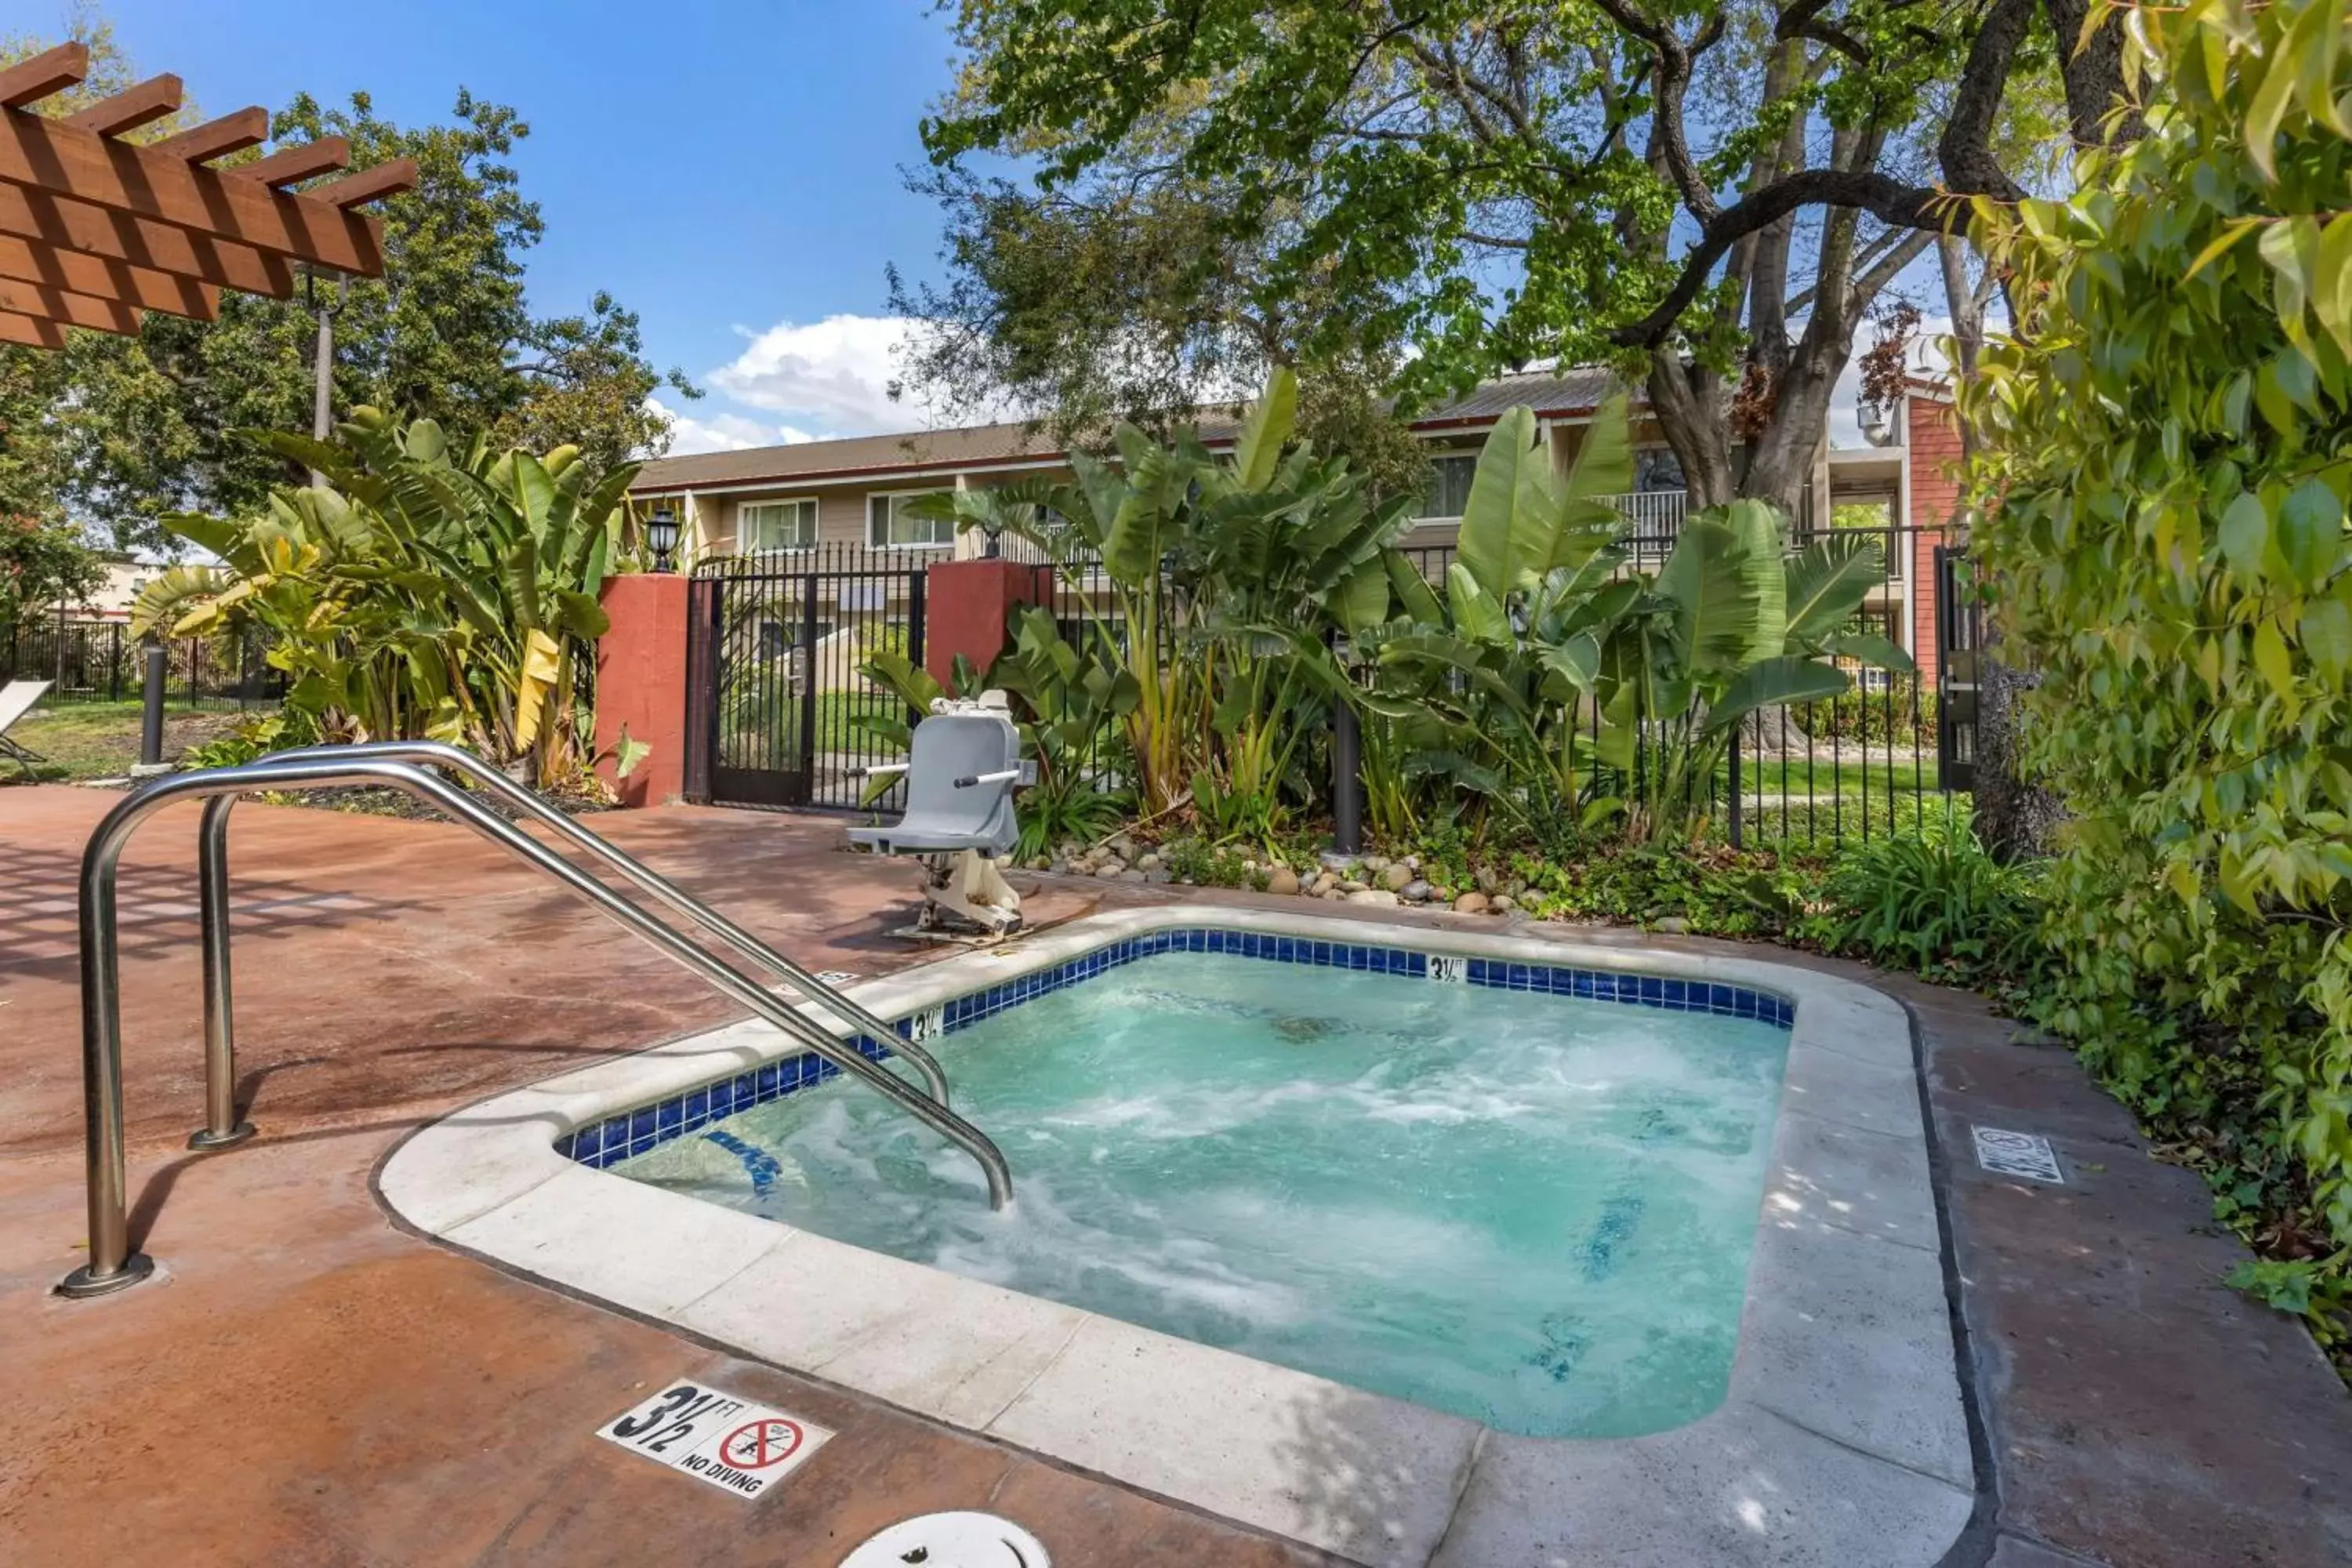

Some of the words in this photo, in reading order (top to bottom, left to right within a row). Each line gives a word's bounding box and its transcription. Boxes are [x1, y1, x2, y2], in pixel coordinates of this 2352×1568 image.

[715, 1399, 744, 1418] FT
[681, 1454, 709, 1471] NO
[704, 1464, 764, 1492] DIVING
